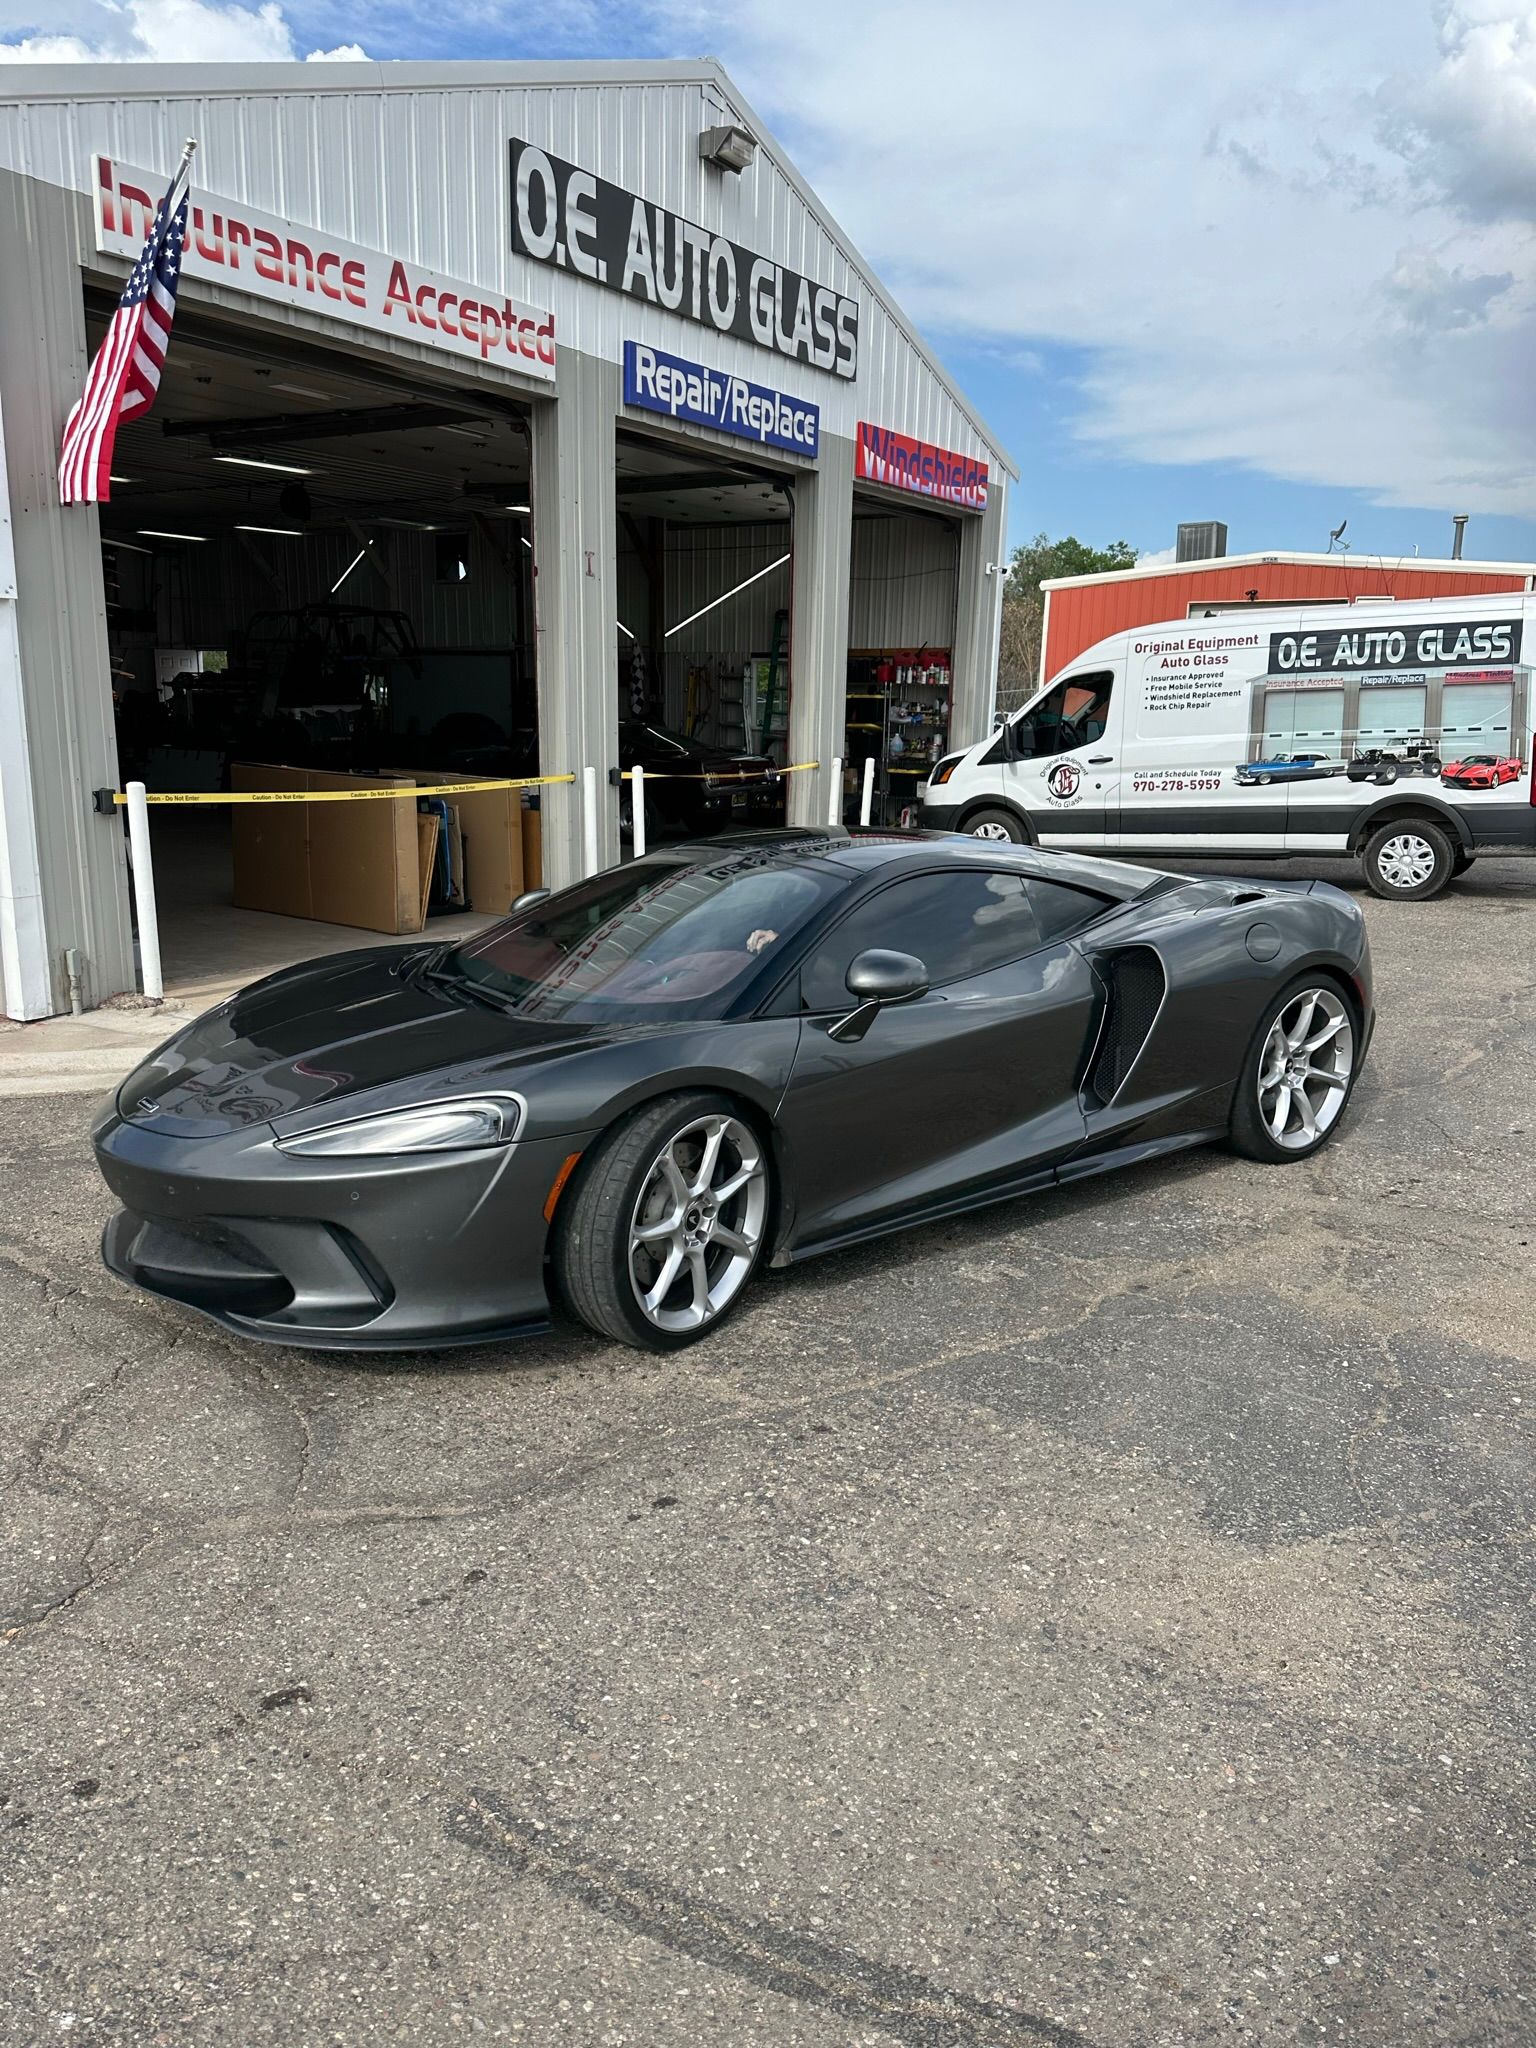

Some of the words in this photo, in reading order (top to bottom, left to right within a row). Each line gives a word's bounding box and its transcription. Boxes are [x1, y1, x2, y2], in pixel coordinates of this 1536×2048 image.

[99, 157, 366, 308] Inurance
[383, 260, 555, 366] Accepted
[517, 145, 608, 283] O.E.
[622, 197, 737, 331] AUTO
[749, 256, 859, 380] GLASS
[635, 344, 815, 446] Repair/Replace
[863, 422, 988, 510] Windshields
[1134, 639, 1185, 655] Original
[1188, 634, 1259, 651] Equipment
[1278, 636, 1321, 668] O.E.
[1332, 631, 1406, 666] AUTO
[1417, 625, 1512, 662] GLASS
[1160, 658, 1190, 669] Auto
[1193, 655, 1229, 666] Glass
[1188, 671, 1224, 681] Approved
[1362, 675, 1424, 686] Repair/Replace
[1168, 682, 1193, 691] Mobile
[1194, 681, 1223, 689] Service
[1150, 692, 1191, 701] Windshield
[1192, 690, 1242, 700] Replacement
[1168, 703, 1185, 711] Chip
[1186, 701, 1211, 710] Repair
[1040, 756, 1060, 778] Original
[1060, 755, 1089, 776] Equipment
[1164, 770, 1198, 778] Schedule
[1200, 770, 1222, 778] Today
[1133, 779, 1221, 792] 970-278-5959
[1045, 796, 1062, 808] Auto
[1063, 795, 1083, 808] Glass
